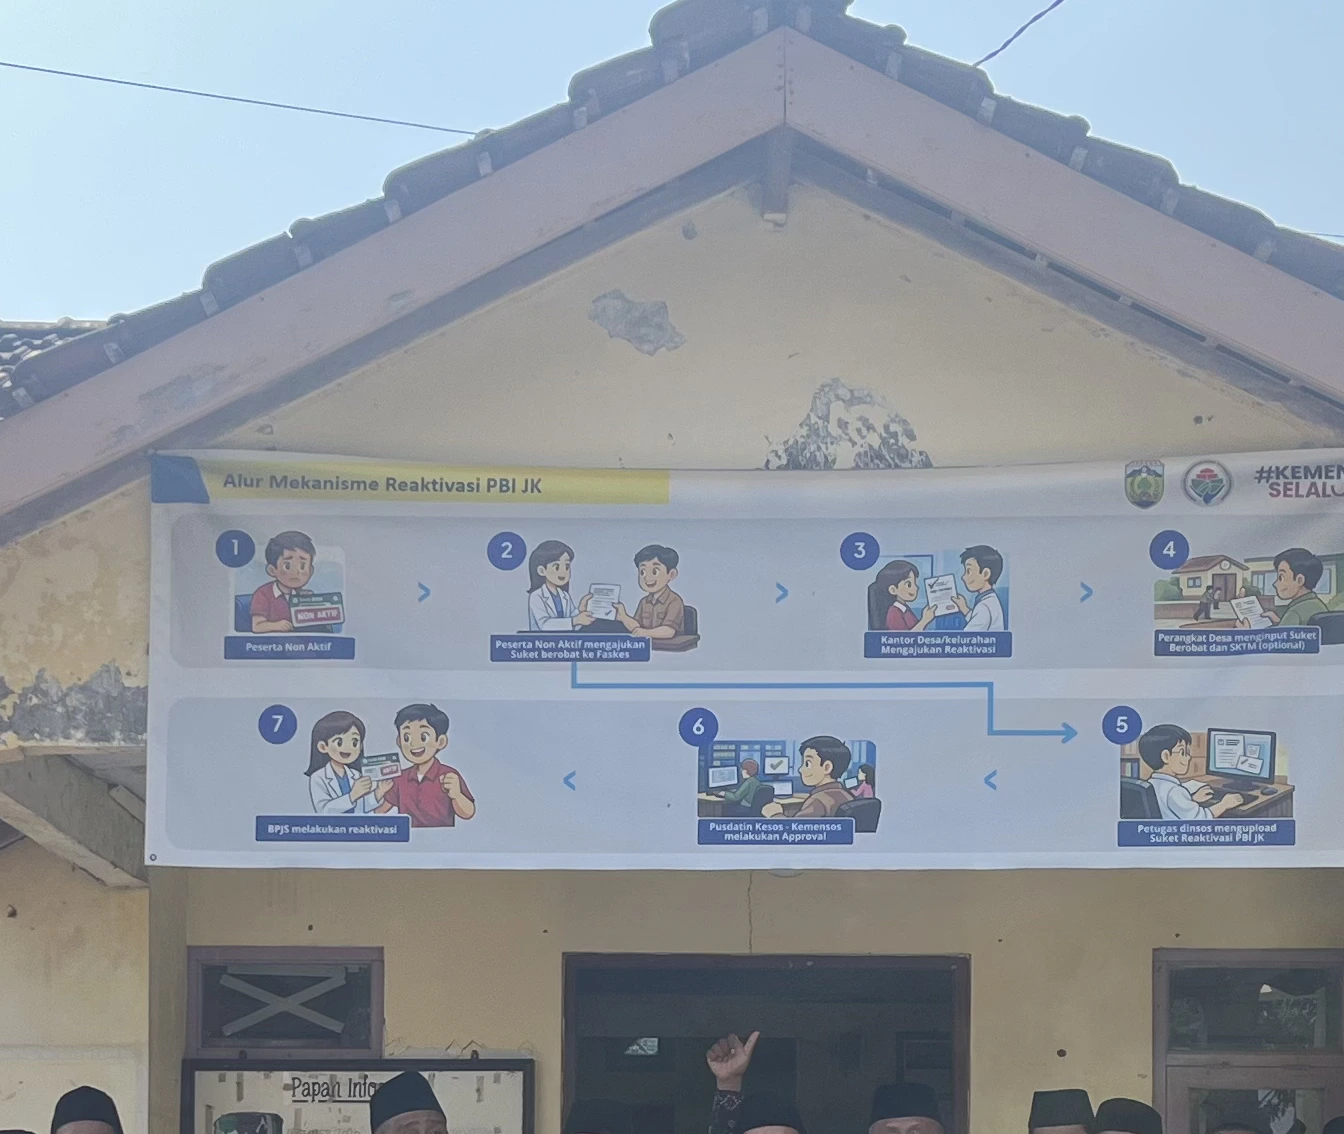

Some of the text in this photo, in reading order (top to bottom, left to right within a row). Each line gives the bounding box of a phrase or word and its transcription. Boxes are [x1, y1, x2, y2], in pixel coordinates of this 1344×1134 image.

[223, 474, 542, 494] Alur Mekanisme Reaktivasi PBI JK
[231, 539, 239, 556] 1
[501, 542, 513, 558] 2
[853, 542, 865, 559] 3
[1162, 541, 1176, 558] 4
[881, 636, 996, 644] Kantor Desa/kelurahan
[1158, 630, 1318, 644] Perangkat Desa menginput Suket
[246, 642, 332, 652] Peserta Non Aktif
[495, 640, 646, 652] Peserta Non Aktif mengajukan
[881, 645, 996, 656] Mengajukan Reaktivasi
[1169, 640, 1306, 652] Berobat dan SKTM (optional)
[511, 650, 630, 659] Suket berobat ke Faskes
[272, 716, 283, 732] 7
[692, 718, 704, 735] 6
[1116, 716, 1128, 733] 5
[267, 824, 398, 835] BPJS melakukan reaktivasi
[709, 822, 753, 831] Pusdatin
[755, 822, 783, 831] Kesos
[791, 822, 842, 831] Kemensos
[1137, 824, 1277, 835] Petugas dinsos mengupload
[724, 832, 827, 842] melakukan Approval
[1150, 832, 1265, 843] Suket Reaktivasi PBI JK
[291, 1077, 342, 1103] Papan
